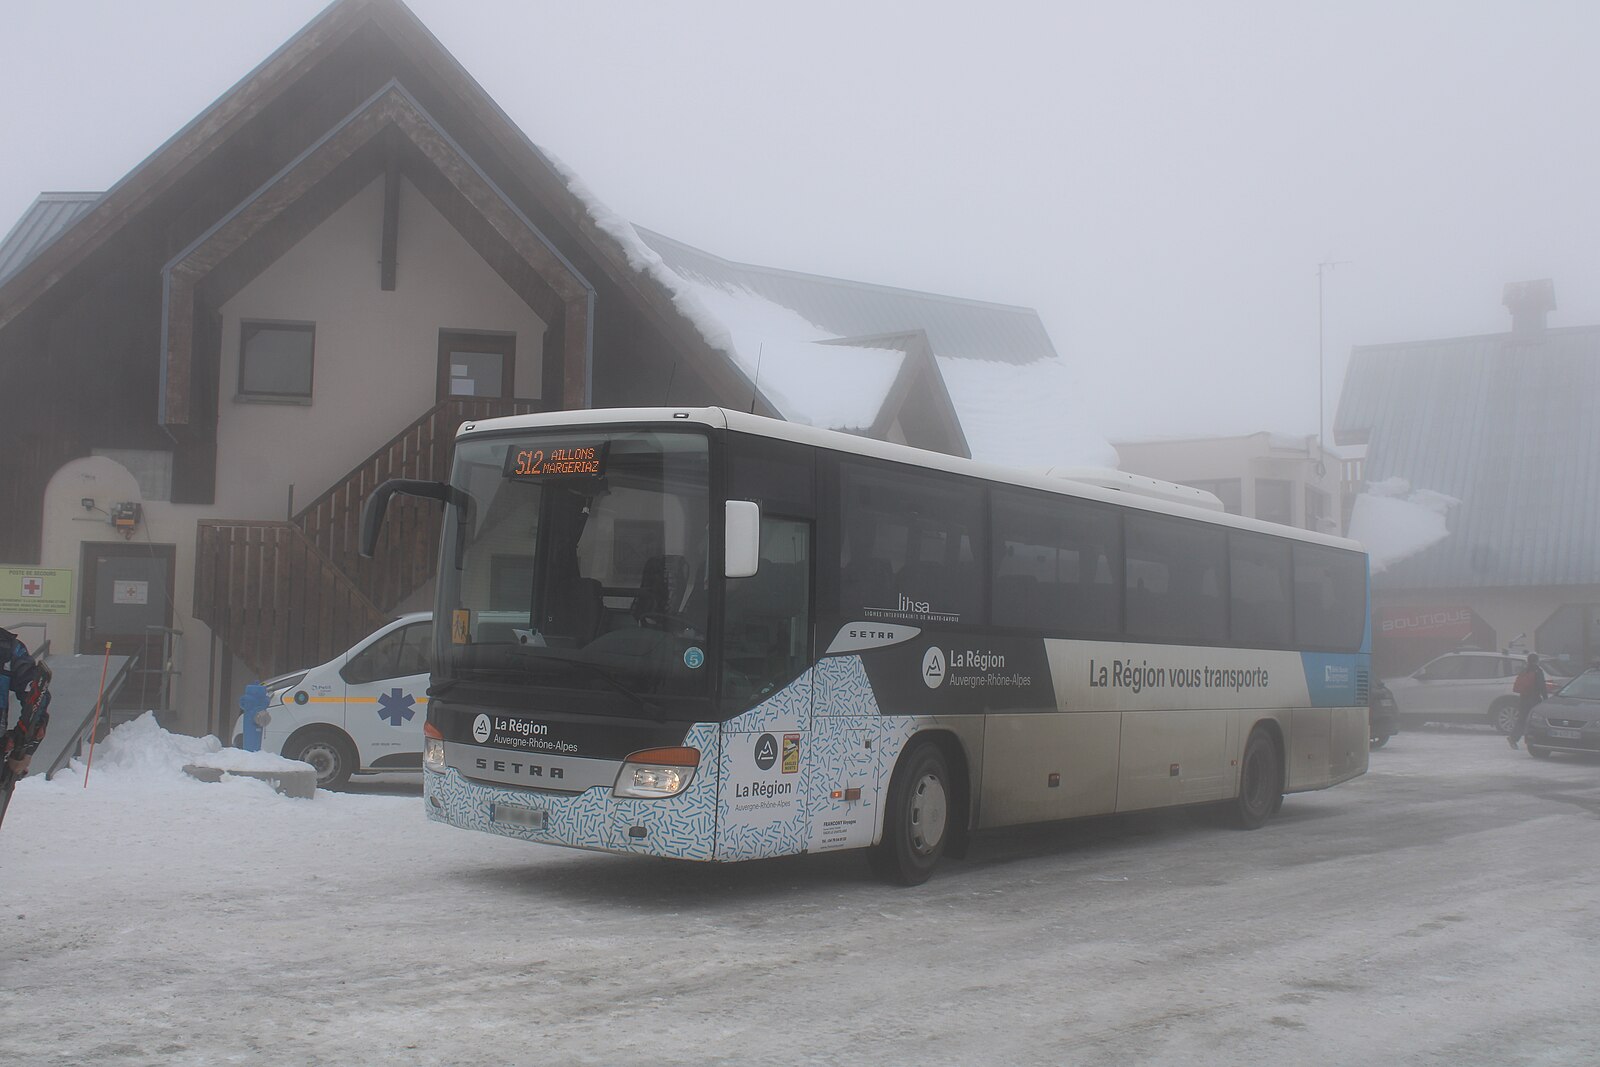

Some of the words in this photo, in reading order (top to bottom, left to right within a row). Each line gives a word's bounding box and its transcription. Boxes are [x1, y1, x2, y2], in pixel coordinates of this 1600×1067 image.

[515, 450, 544, 475] S12
[551, 448, 595, 461] AILLONS
[542, 461, 599, 474] MARGERIAZ
[898, 592, 930, 614] lihsa
[1382, 609, 1472, 632] BOUTIQUE
[850, 630, 894, 639] SETRA
[950, 650, 963, 667] La
[966, 651, 1005, 672] Région
[949, 673, 1031, 688] Auvergne-Rhône-Alpes
[1089, 659, 1108, 687] La
[1112, 659, 1165, 694] Région
[1169, 667, 1201, 688] vous
[1204, 665, 1269, 693] transporte
[494, 717, 507, 732] La
[509, 718, 548, 736] Région
[493, 735, 578, 752] Auvergne-Rhône-Alpes
[476, 758, 564, 779] SETRA
[735, 783, 749, 798] La
[752, 781, 792, 798] Région
[735, 800, 791, 812] Auvergne-Rhône-Alpes
